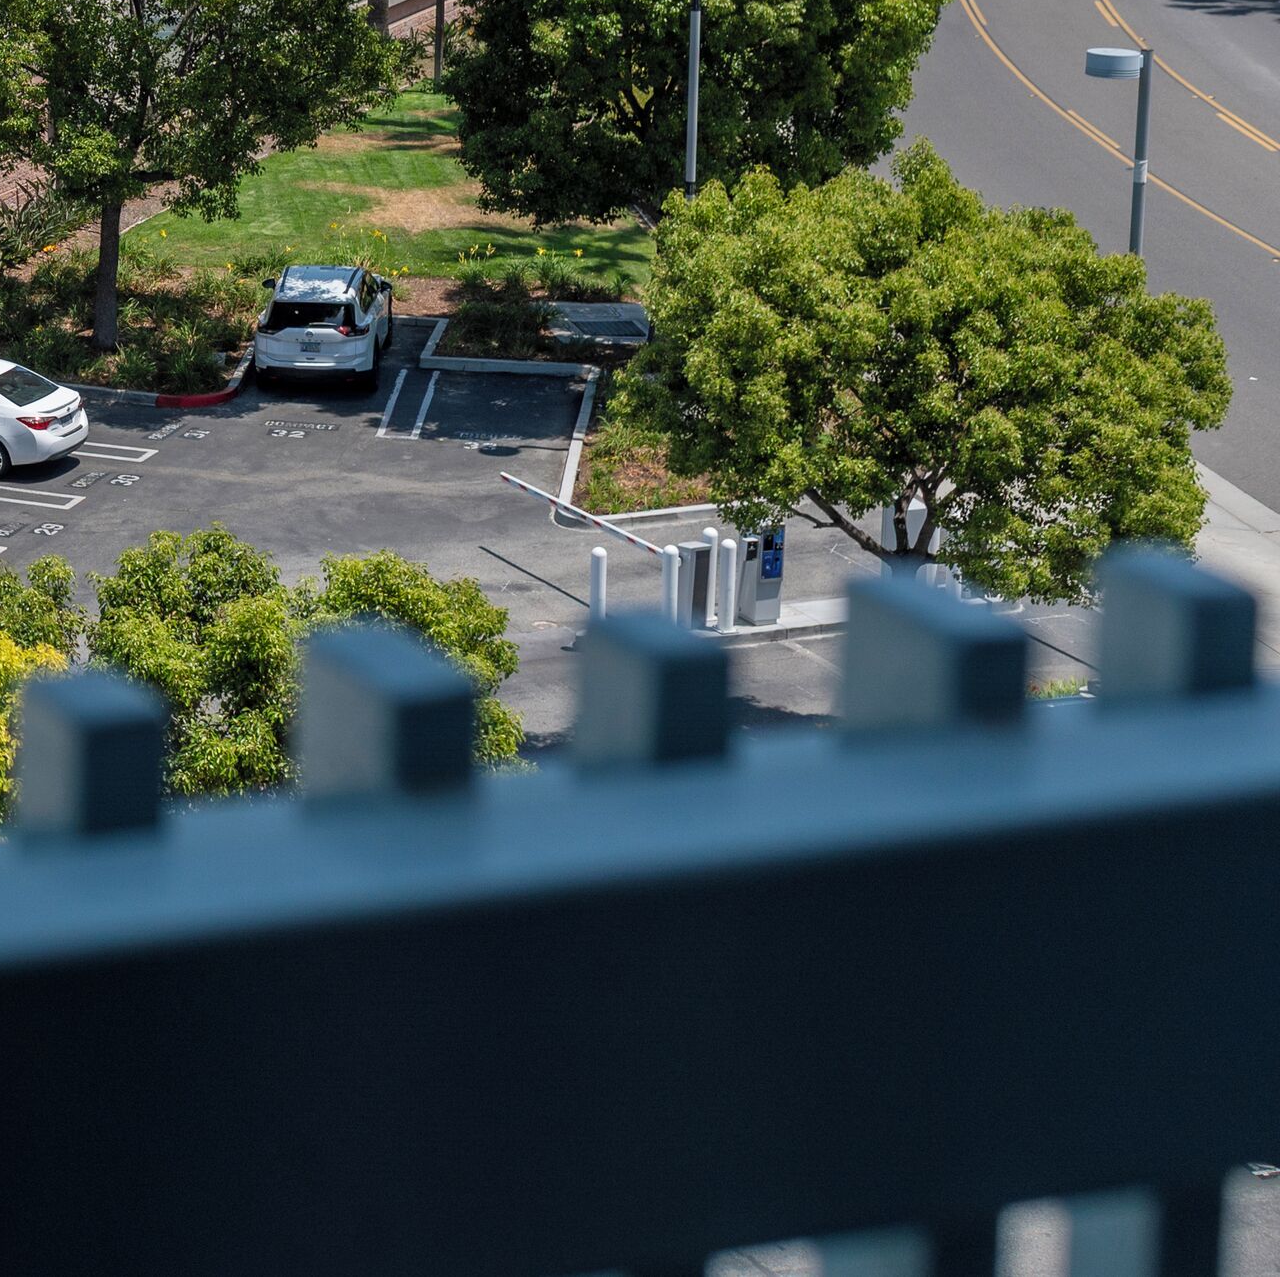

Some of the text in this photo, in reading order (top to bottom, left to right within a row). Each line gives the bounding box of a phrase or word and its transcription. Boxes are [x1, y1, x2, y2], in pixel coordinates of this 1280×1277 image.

[271, 429, 305, 439] 32
[110, 474, 140, 486] 30
[34, 523, 64, 536] 29
